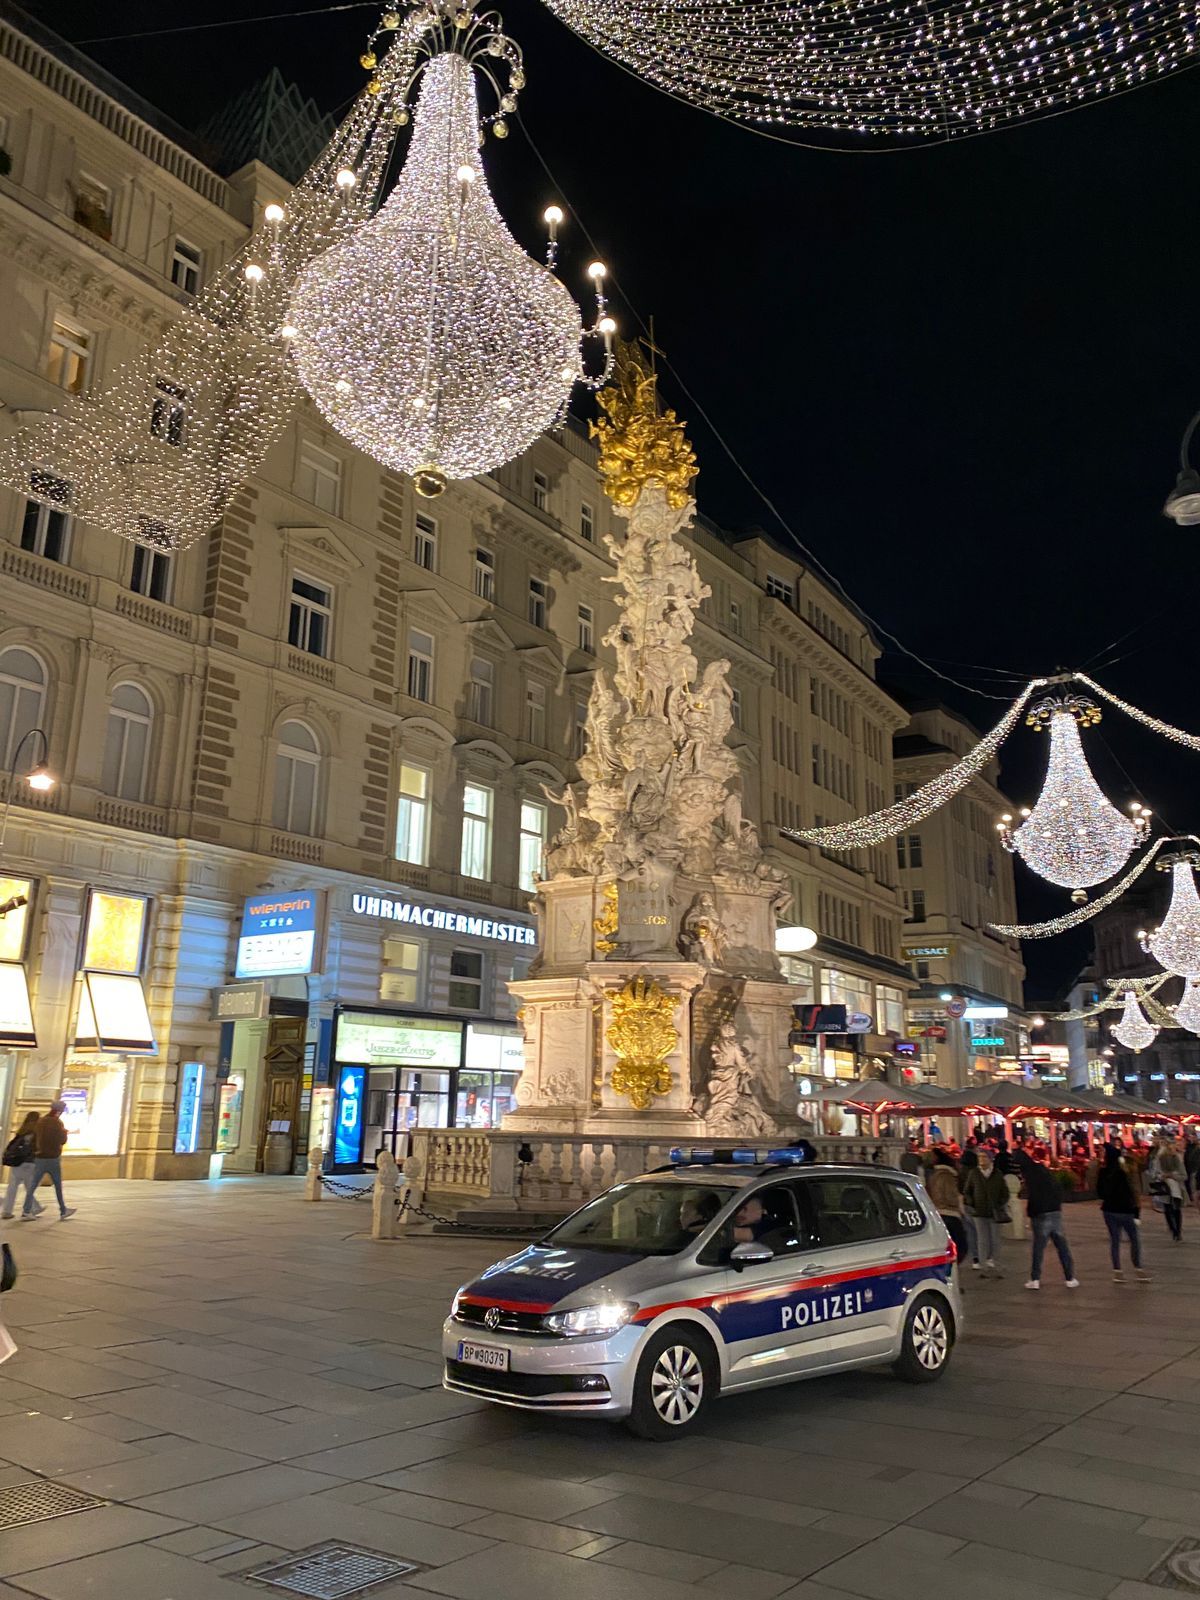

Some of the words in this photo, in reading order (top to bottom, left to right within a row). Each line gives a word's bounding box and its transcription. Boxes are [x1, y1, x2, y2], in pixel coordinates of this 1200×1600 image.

[250, 899, 311, 915] wienerin
[352, 894, 536, 945] UHRMACHERMEISTER
[906, 947, 949, 956] VERSACE
[508, 1264, 577, 1281] LIZEI
[781, 1291, 862, 1329] POLIZEI
[479, 1349, 504, 1367] 90379
